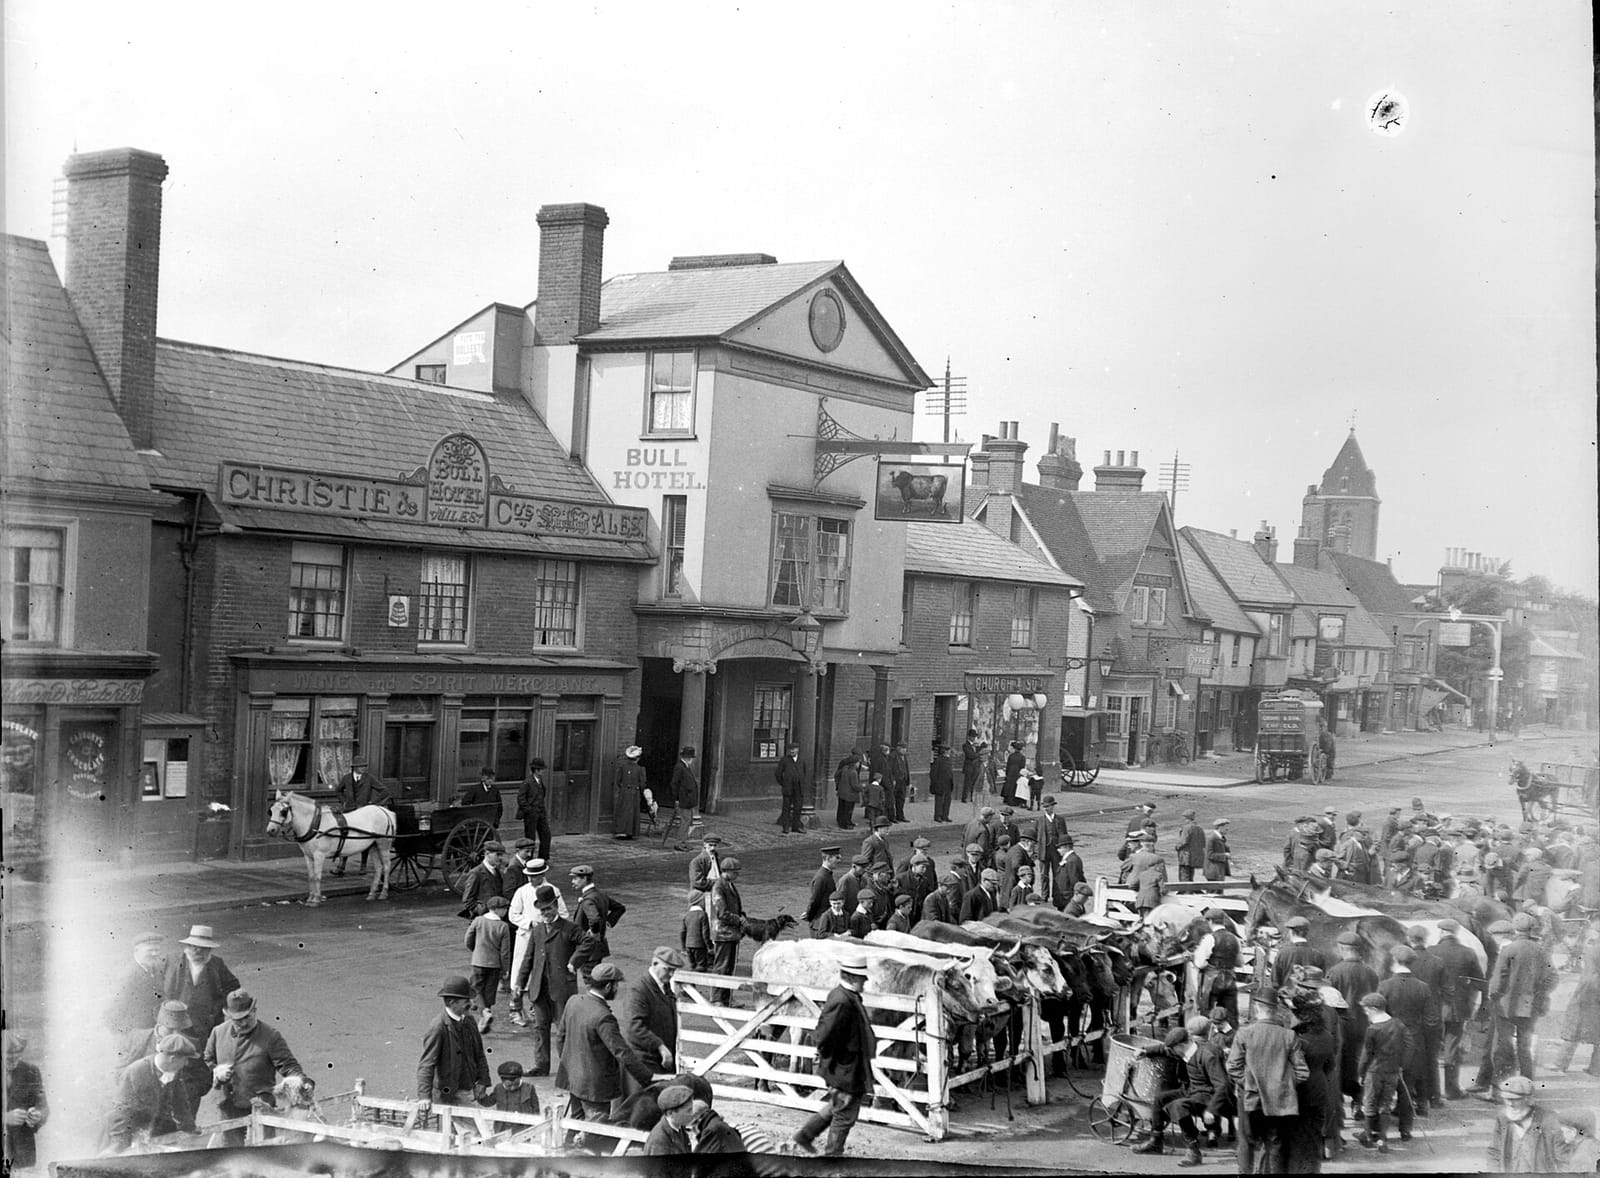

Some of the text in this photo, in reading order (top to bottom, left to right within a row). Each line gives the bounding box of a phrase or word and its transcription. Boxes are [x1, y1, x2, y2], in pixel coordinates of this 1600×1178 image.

[626, 448, 688, 467] BULL
[434, 458, 483, 483] BULL
[229, 469, 390, 514] CHRISTIE
[396, 491, 418, 517] &
[430, 481, 485, 504] HOTEL
[411, 673, 476, 691] SPIRIT
[975, 677, 1012, 692] CHURCH
